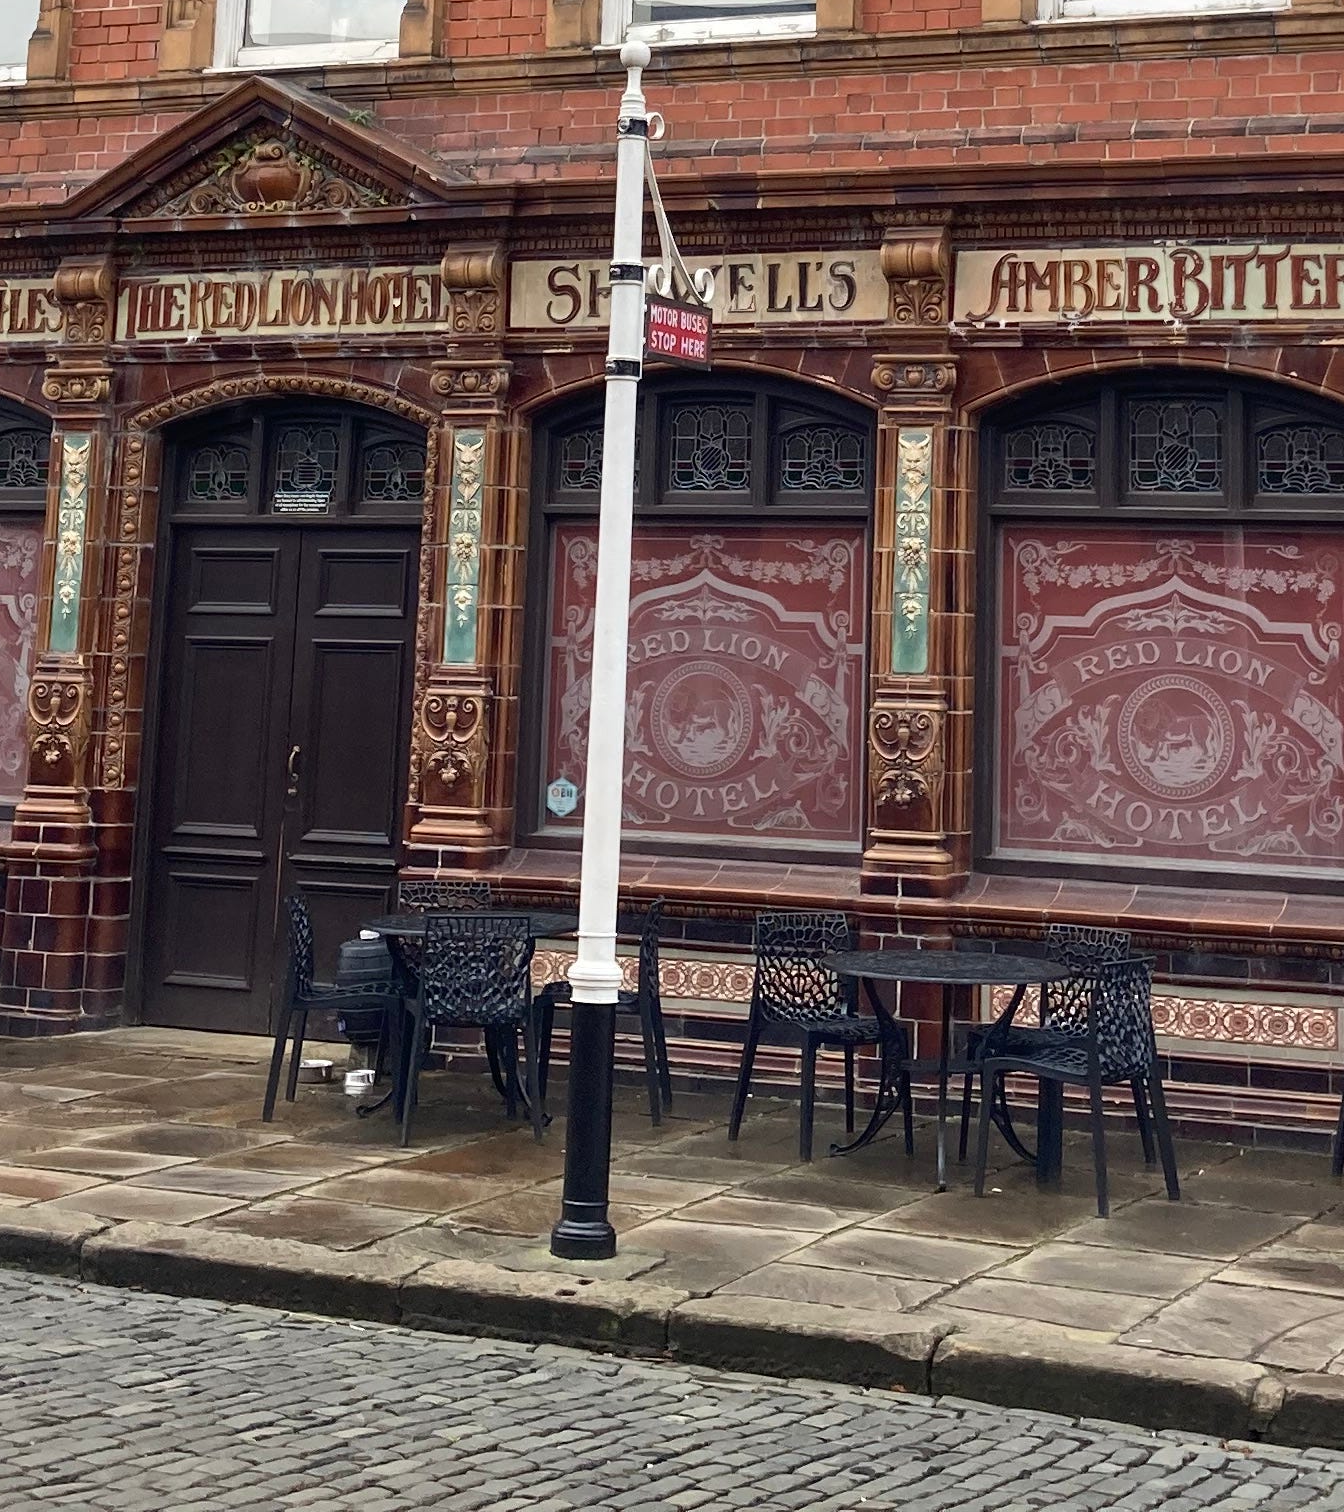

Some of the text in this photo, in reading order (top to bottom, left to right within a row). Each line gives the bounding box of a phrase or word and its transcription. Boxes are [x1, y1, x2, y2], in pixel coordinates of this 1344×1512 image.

[118, 269, 450, 339] THE RED LION HOTEL
[546, 260, 857, 324] SHELL'S
[966, 252, 1163, 321] AMBER
[650, 303, 709, 334] MOTOR BUSES
[651, 330, 705, 359] STOP HERE
[702, 629, 790, 671] LION
[1073, 640, 1275, 686] RED LION
[624, 760, 779, 815] HOTEL
[1086, 780, 1268, 839] HOTEL
